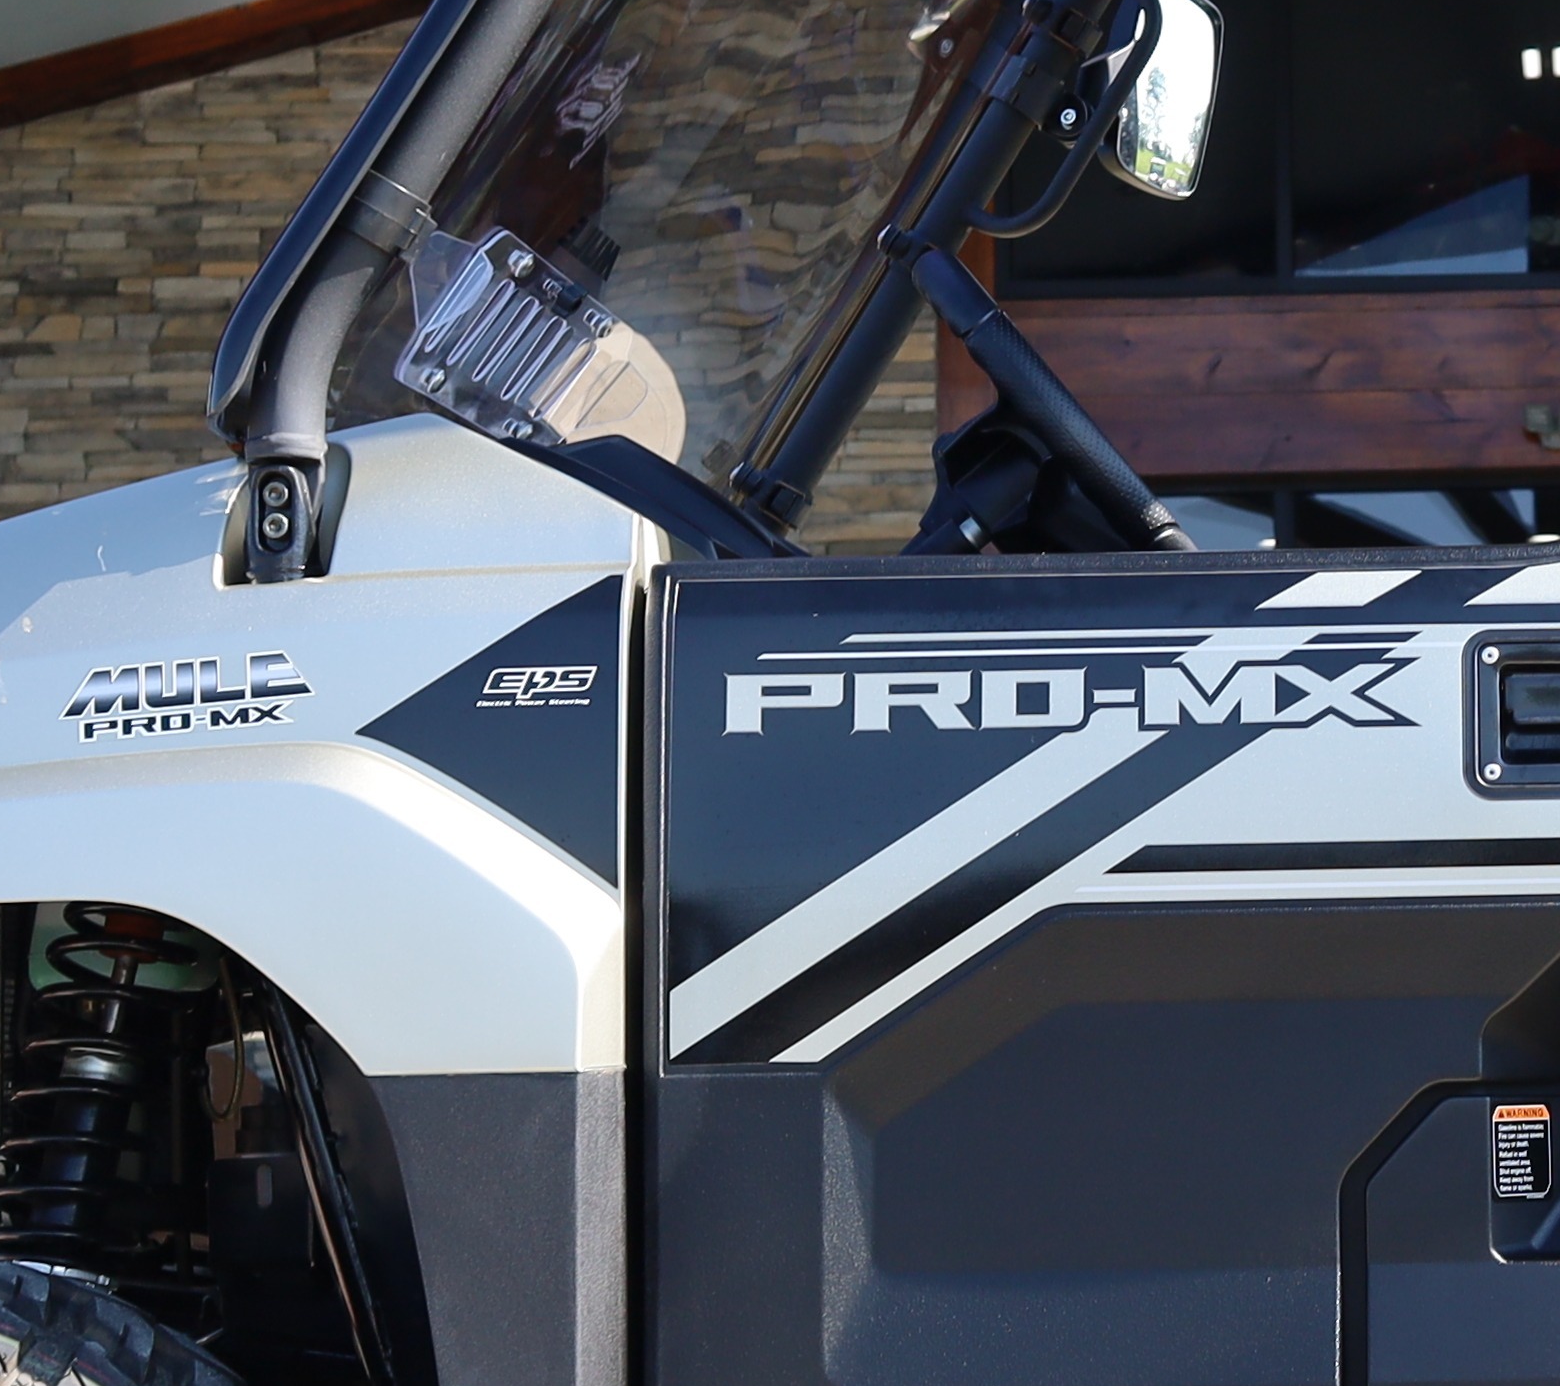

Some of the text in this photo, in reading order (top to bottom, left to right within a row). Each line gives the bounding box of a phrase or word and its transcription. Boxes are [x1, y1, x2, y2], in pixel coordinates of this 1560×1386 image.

[59, 650, 315, 719] MULE
[482, 665, 598, 700] EPS
[722, 661, 1420, 736] PRO-MX
[80, 701, 290, 742] PRO-MX
[515, 699, 546, 707] Power
[1506, 1108, 1543, 1118] WARNING
